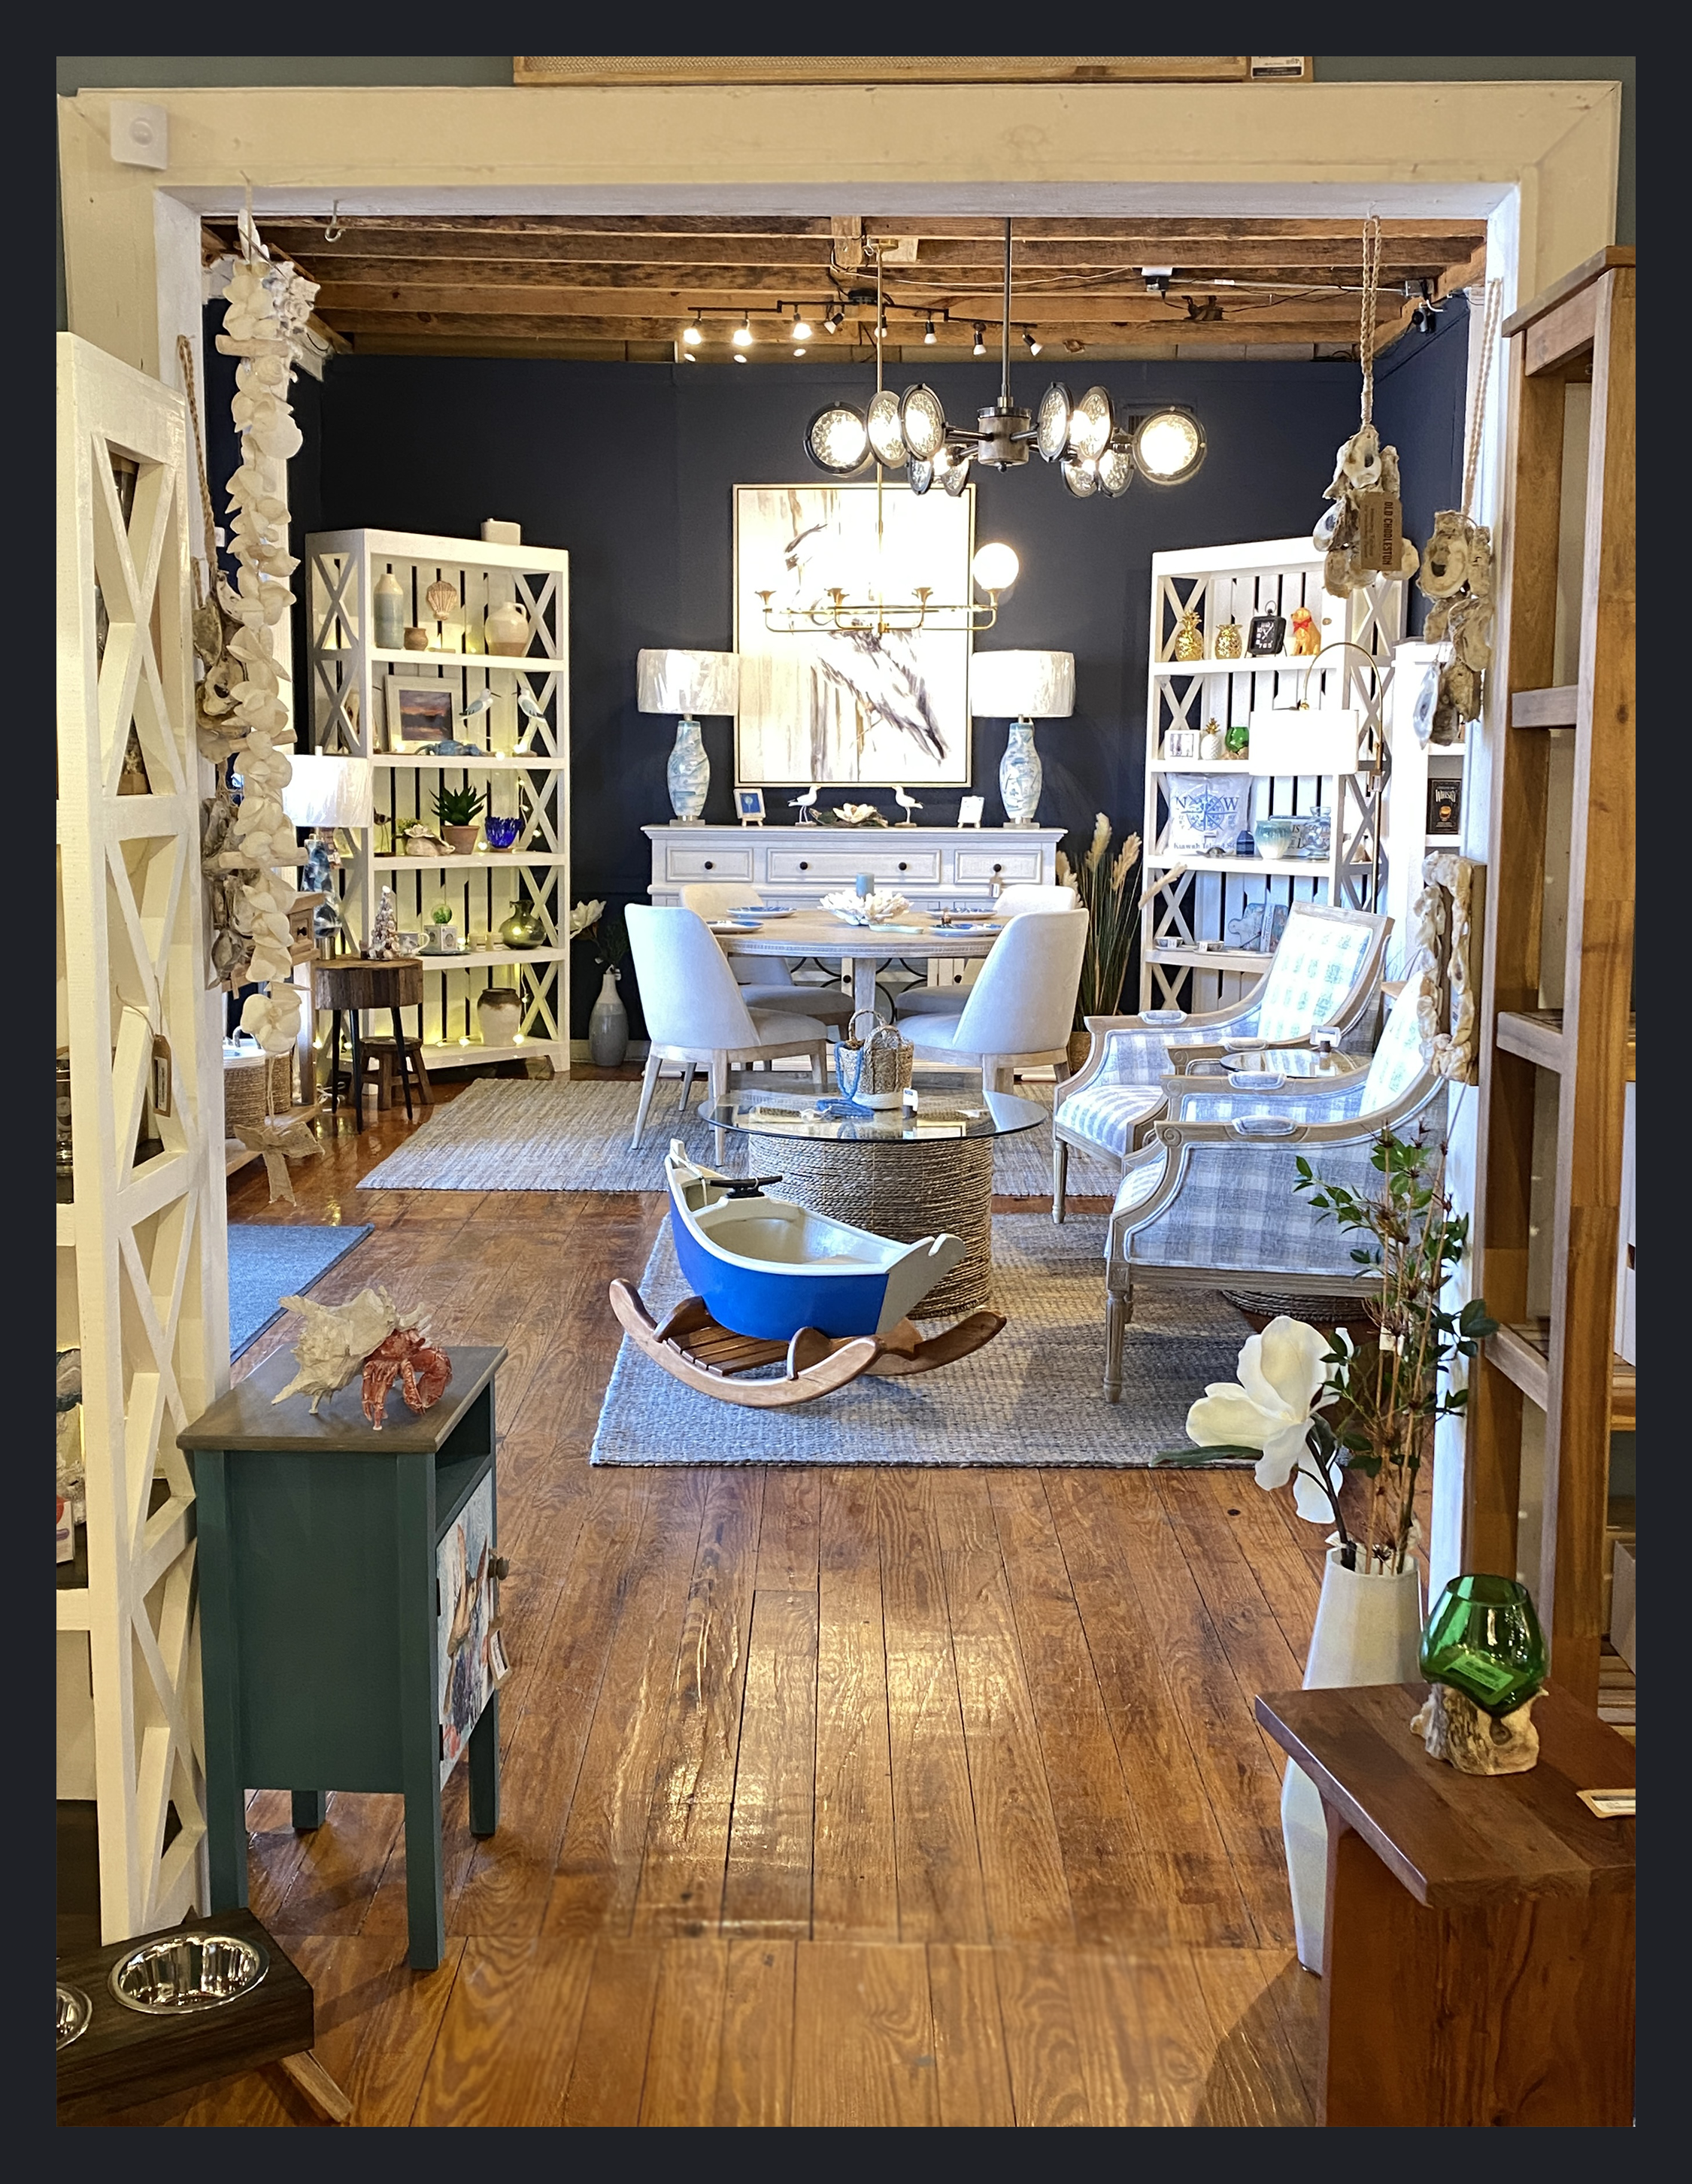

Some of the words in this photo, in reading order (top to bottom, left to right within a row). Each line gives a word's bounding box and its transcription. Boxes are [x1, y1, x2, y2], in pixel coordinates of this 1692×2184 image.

[1384, 502, 1393, 516] OLD
[1175, 796, 1187, 808] N
[1224, 797, 1239, 811] W
